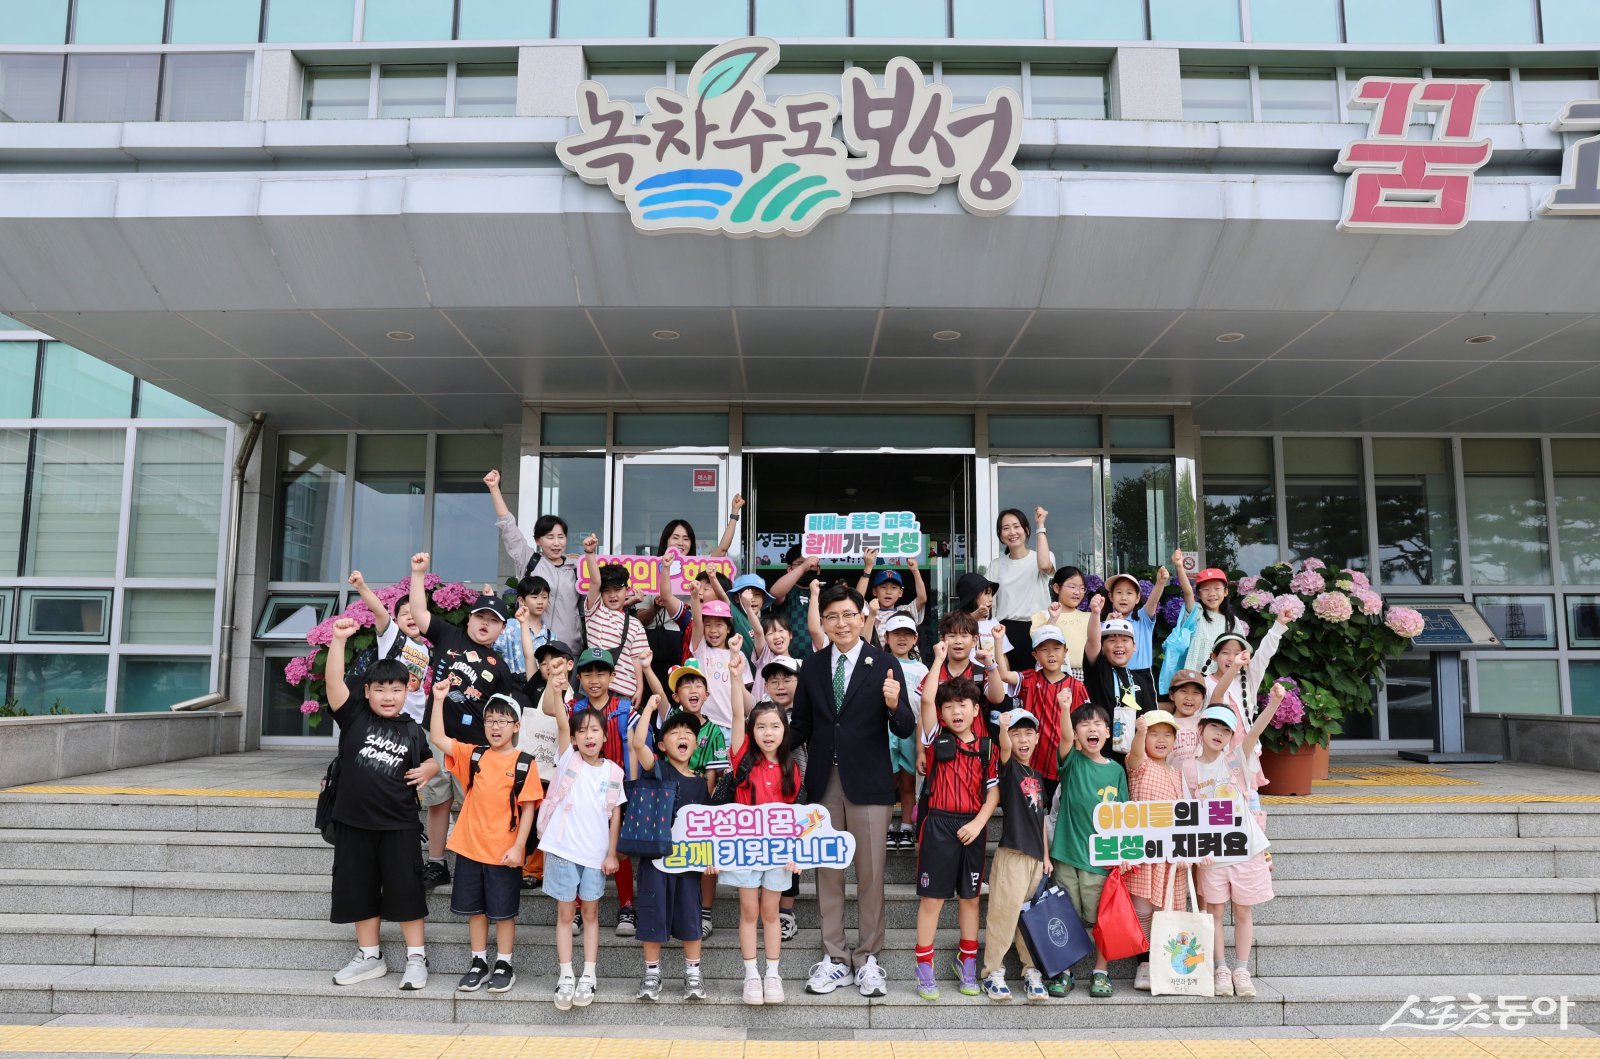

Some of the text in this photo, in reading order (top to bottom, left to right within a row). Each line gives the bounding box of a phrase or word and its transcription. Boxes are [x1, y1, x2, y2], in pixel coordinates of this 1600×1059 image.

[567, 66, 1012, 200] 녹차수도 보성
[1346, 81, 1489, 224] 꿈
[808, 513, 918, 531] 미래를 품은 교육,
[448, 661, 478, 685] JORDAN
[359, 746, 403, 767] MOMENT
[364, 734, 408, 756] SAVOUR
[686, 807, 802, 838] 보성의 꿈,
[1098, 801, 1242, 830] 아이들의 꿈,
[719, 836, 848, 866] 키워갑니다
[1094, 831, 1248, 860] 보성이 지켜요
